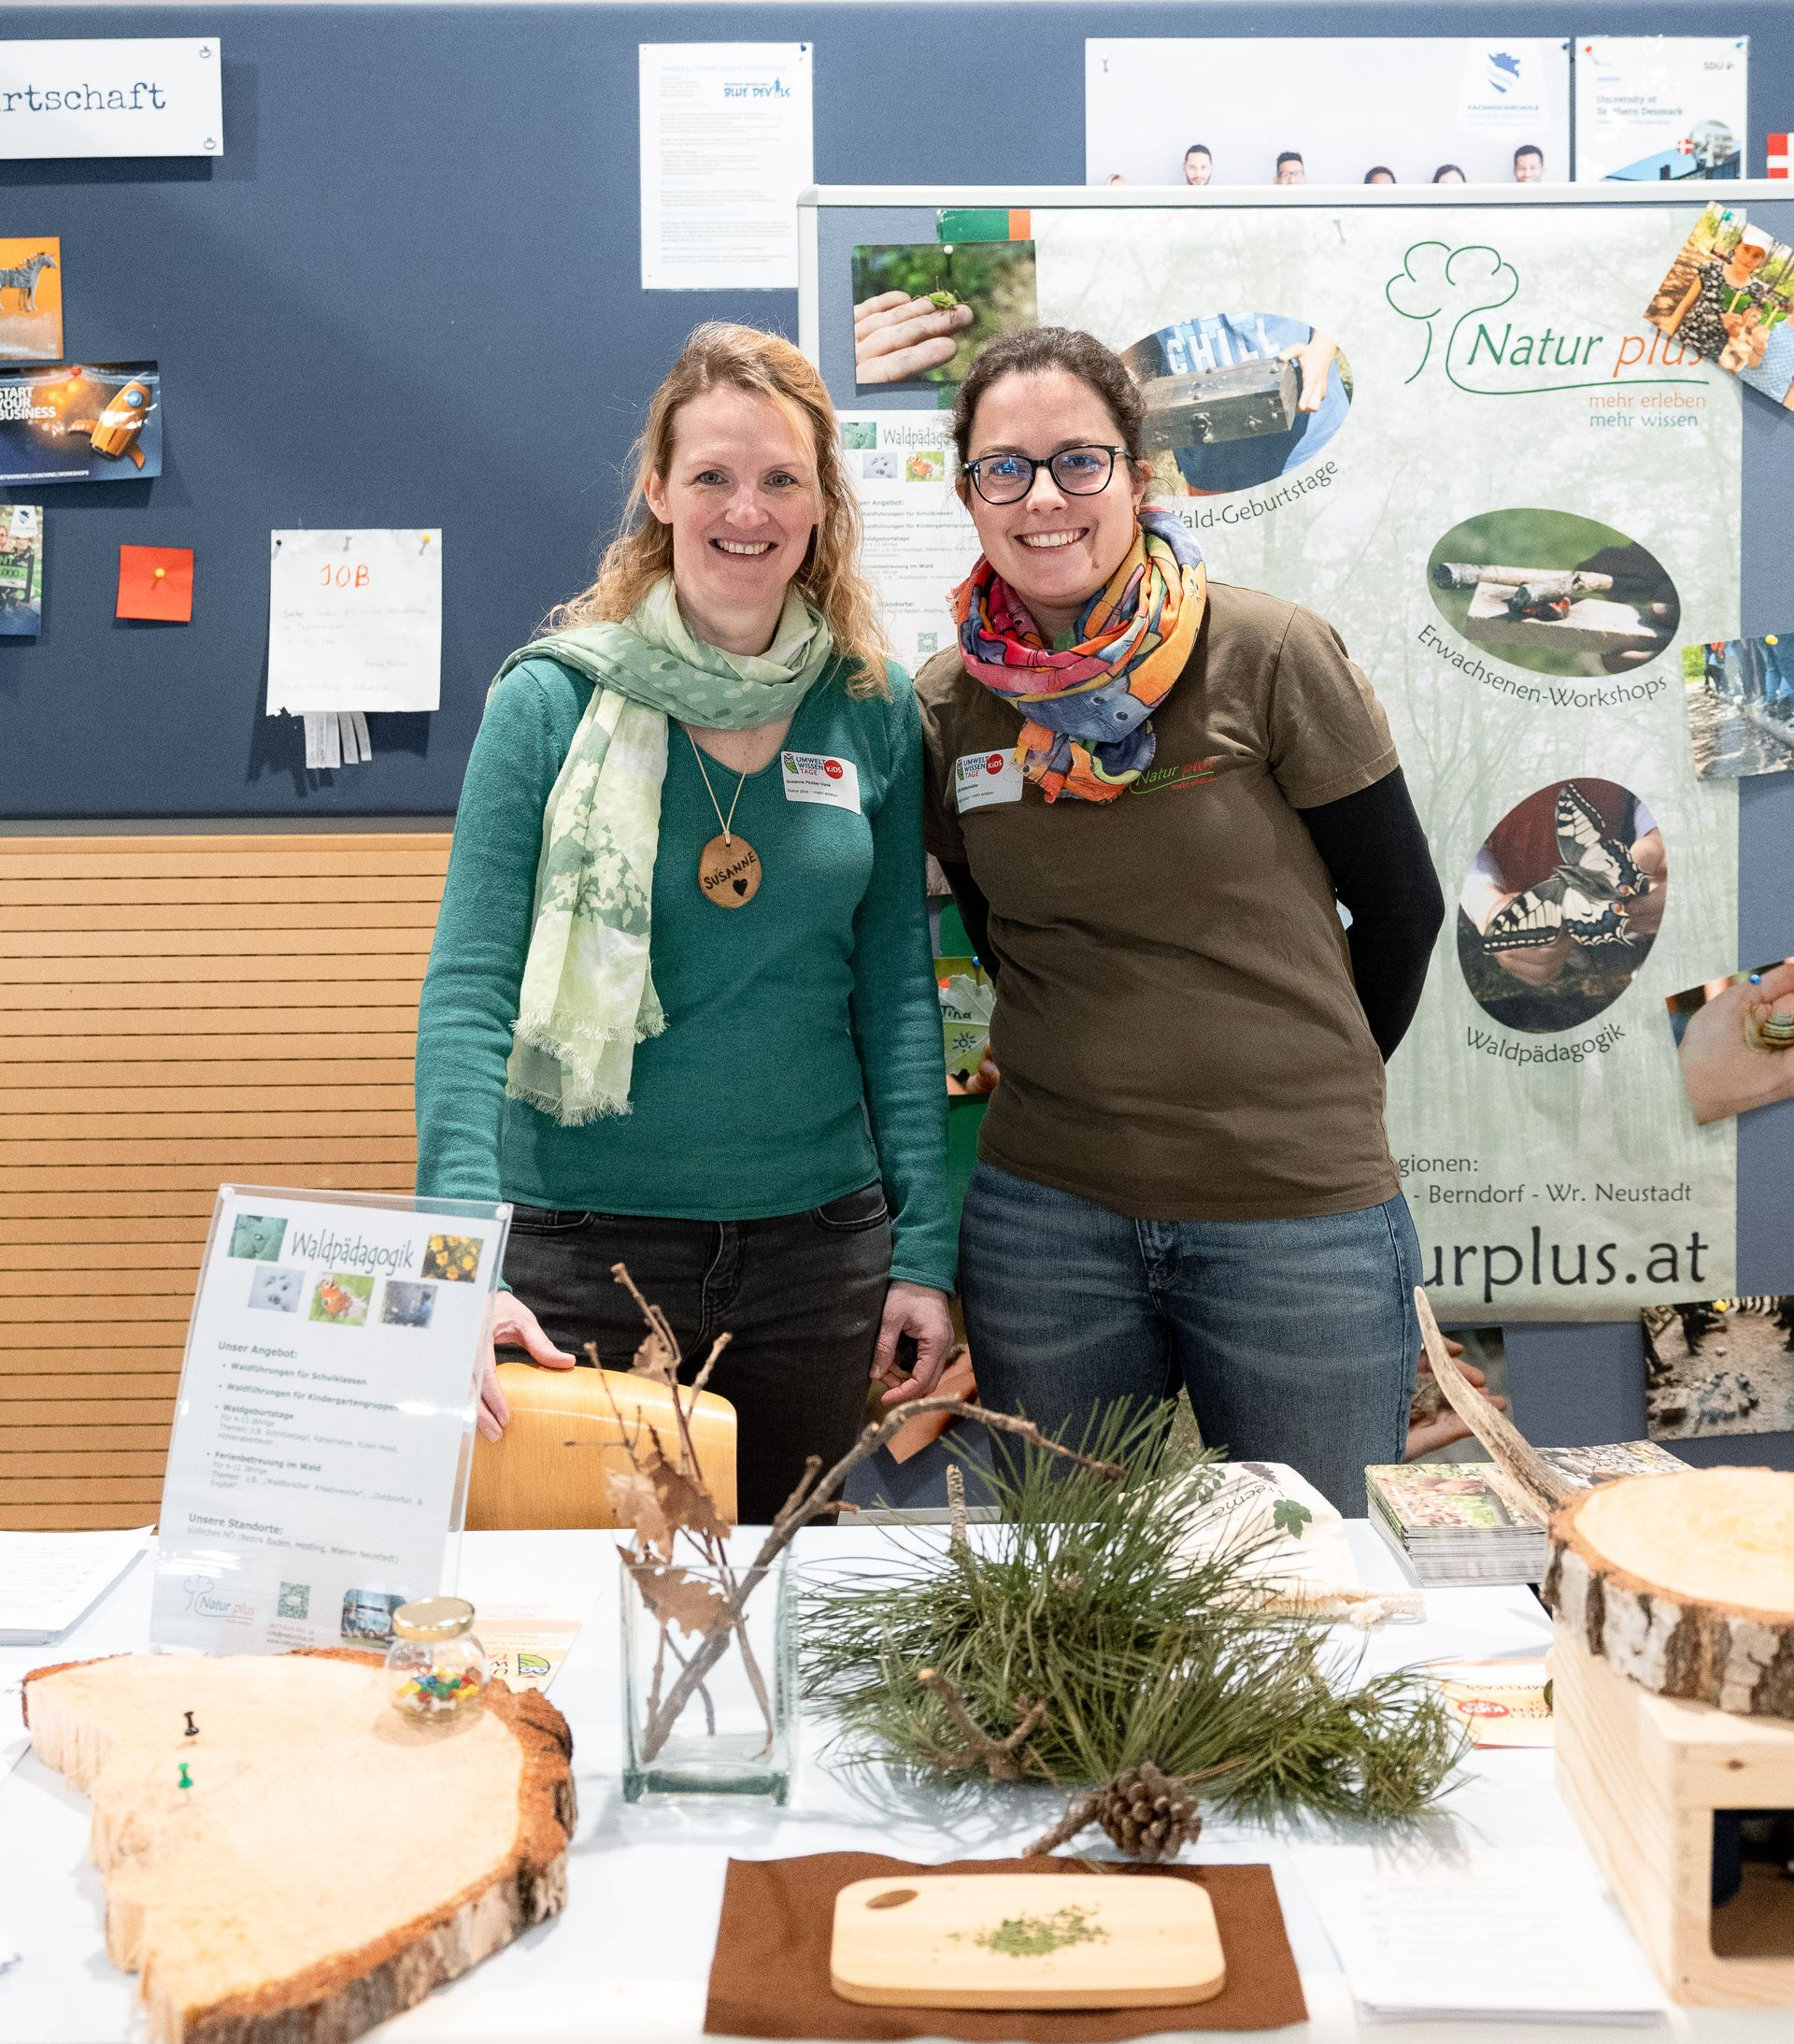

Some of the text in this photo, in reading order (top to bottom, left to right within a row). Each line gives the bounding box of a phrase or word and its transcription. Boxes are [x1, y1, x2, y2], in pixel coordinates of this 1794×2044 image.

[0, 81, 166, 112] rtschaft
[724, 87, 748, 97] BLUE
[1466, 322, 1604, 366] Natur
[1588, 392, 1706, 408] mehr erleben
[1589, 411, 1699, 427] mehr wissen
[1172, 460, 1339, 530] ald-Geburtstage
[319, 562, 371, 589] JOB
[1417, 623, 1668, 708] Erwachsenen-Workshops
[795, 756, 826, 765] UMWELT
[797, 763, 824, 771] WISSEN
[962, 755, 990, 766] UMWELT
[963, 763, 986, 773] WISSEN
[964, 771, 979, 779] TAGE
[1135, 765, 1179, 787] Natur
[703, 850, 757, 890] SUSANNE
[1466, 1022, 1627, 1067] Waldpädagogik
[1398, 1153, 1479, 1178] gionen:
[1429, 1183, 1526, 1204] Berndorf
[1545, 1182, 1587, 1204] Wr.
[1595, 1182, 1692, 1203] Neustadt
[292, 1228, 415, 1277] Waldpädagogik
[1423, 1225, 1710, 1304] urplus.at
[218, 1340, 298, 1359] Unser Angebot:
[231, 1362, 367, 1386] Waldführungen für Schulklassen
[227, 1382, 291, 1398] Waldführungen
[293, 1391, 306, 1400] für
[222, 1404, 294, 1421] Waldgeburtstage
[214, 1451, 284, 1469] Ferienbetreuung
[299, 1462, 321, 1473] Wald
[188, 1512, 284, 1536] Unsere Standorte:
[198, 1594, 232, 1612] Natur
